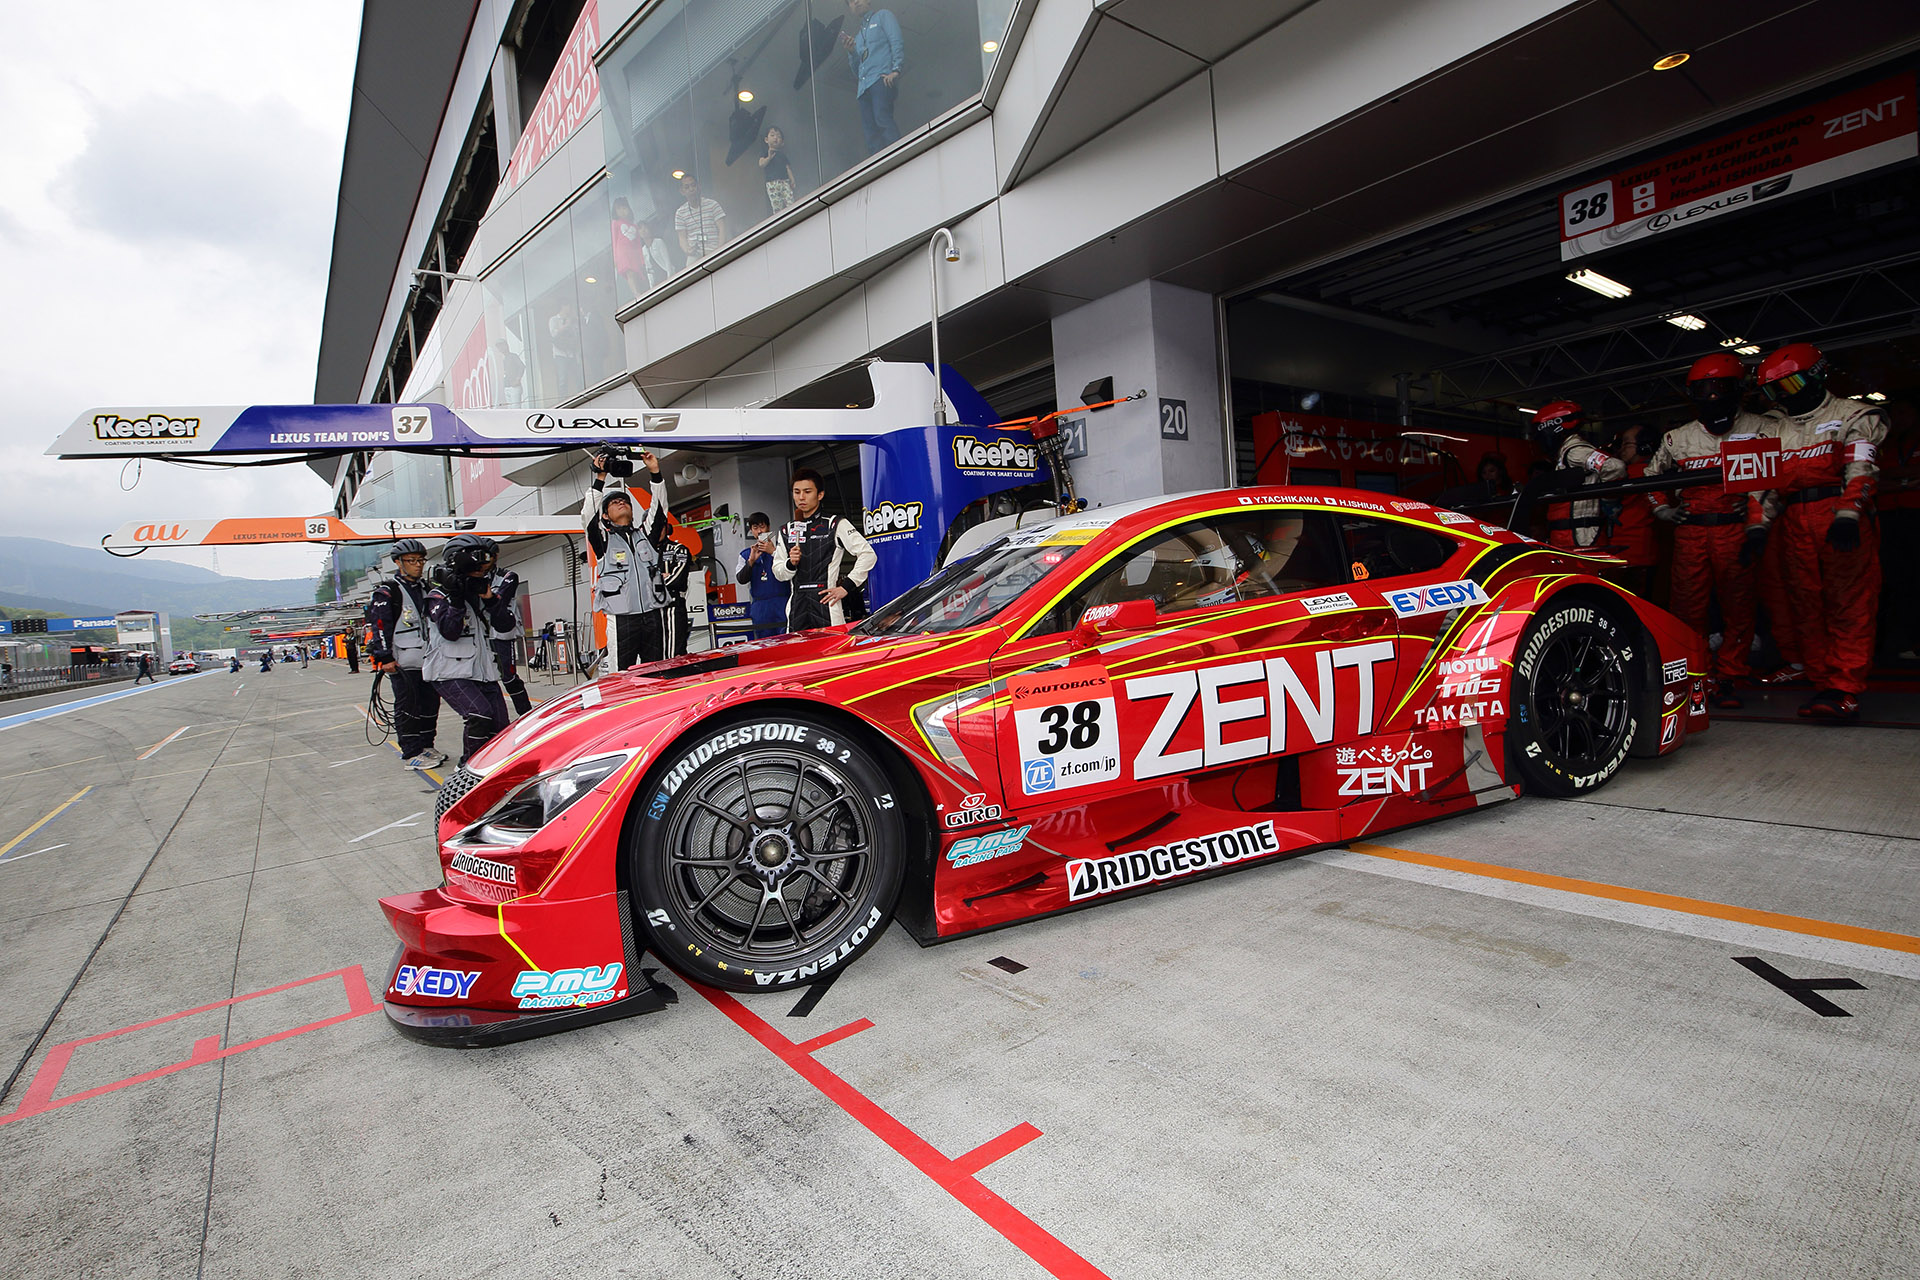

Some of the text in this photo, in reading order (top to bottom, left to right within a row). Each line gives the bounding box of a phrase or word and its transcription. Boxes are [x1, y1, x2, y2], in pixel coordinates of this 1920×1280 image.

[536, 14, 597, 150] TOYOTA
[567, 62, 598, 135] BODY
[1823, 96, 1905, 139] ZENT
[1568, 191, 1609, 226] 38
[1673, 190, 1749, 222] LEXUS
[95, 415, 199, 440] KeePer
[396, 415, 428, 435] 37
[557, 417, 640, 430] LEXUS
[1162, 404, 1187, 435] 20
[1536, 416, 1564, 432] GIRO
[270, 431, 390, 444] LEXUS TEAM TOM'S
[1063, 424, 1085, 456] 21
[955, 438, 1039, 468] KeePer
[1726, 450, 1780, 482] ZENT
[1253, 495, 1321, 505] Y.TACHIKAWA
[1339, 498, 1386, 512] H.ISHIURA
[133, 524, 189, 542] au
[233, 531, 304, 541] LEXUS TEAM TOM'S
[308, 523, 327, 535] 36
[403, 522, 453, 531] LEXUS
[902, 533, 915, 541] LIFE
[1353, 566, 1364, 577] 10
[1303, 594, 1350, 608] LEXUS
[1309, 600, 1355, 612] Gazoo Racing
[1392, 582, 1478, 614] EXEDY
[73, 619, 118, 628] Panaso
[713, 606, 747, 618] KeePer
[1082, 603, 1119, 624] EBBRO
[1598, 617, 1617, 638] 38 2
[1518, 607, 1595, 681] BRIDGESTONE
[1438, 656, 1499, 676] MOTUL
[1665, 666, 1687, 683] TRD
[1031, 677, 1107, 695] AUTOBACS
[1124, 640, 1396, 782] ZENT
[1414, 699, 1505, 725] TAKATA
[1037, 700, 1102, 755] 38
[661, 722, 810, 796] BRIDGESTONE
[815, 736, 852, 765] 38 2
[1336, 742, 1433, 765] 遊べ、もっと。
[1573, 717, 1638, 789] POTENZA
[1060, 755, 1117, 777] zf.com/jp
[1336, 761, 1434, 797] ZENT
[945, 803, 1002, 828] GIRO
[451, 850, 517, 885] BRIDGESTONE
[952, 843, 1023, 869] RACING PADS
[1070, 822, 1278, 900] BRIDGESTONE
[754, 905, 883, 987] POTENZA
[396, 966, 480, 998] EXEDY
[518, 991, 615, 1009] RACING PADS
